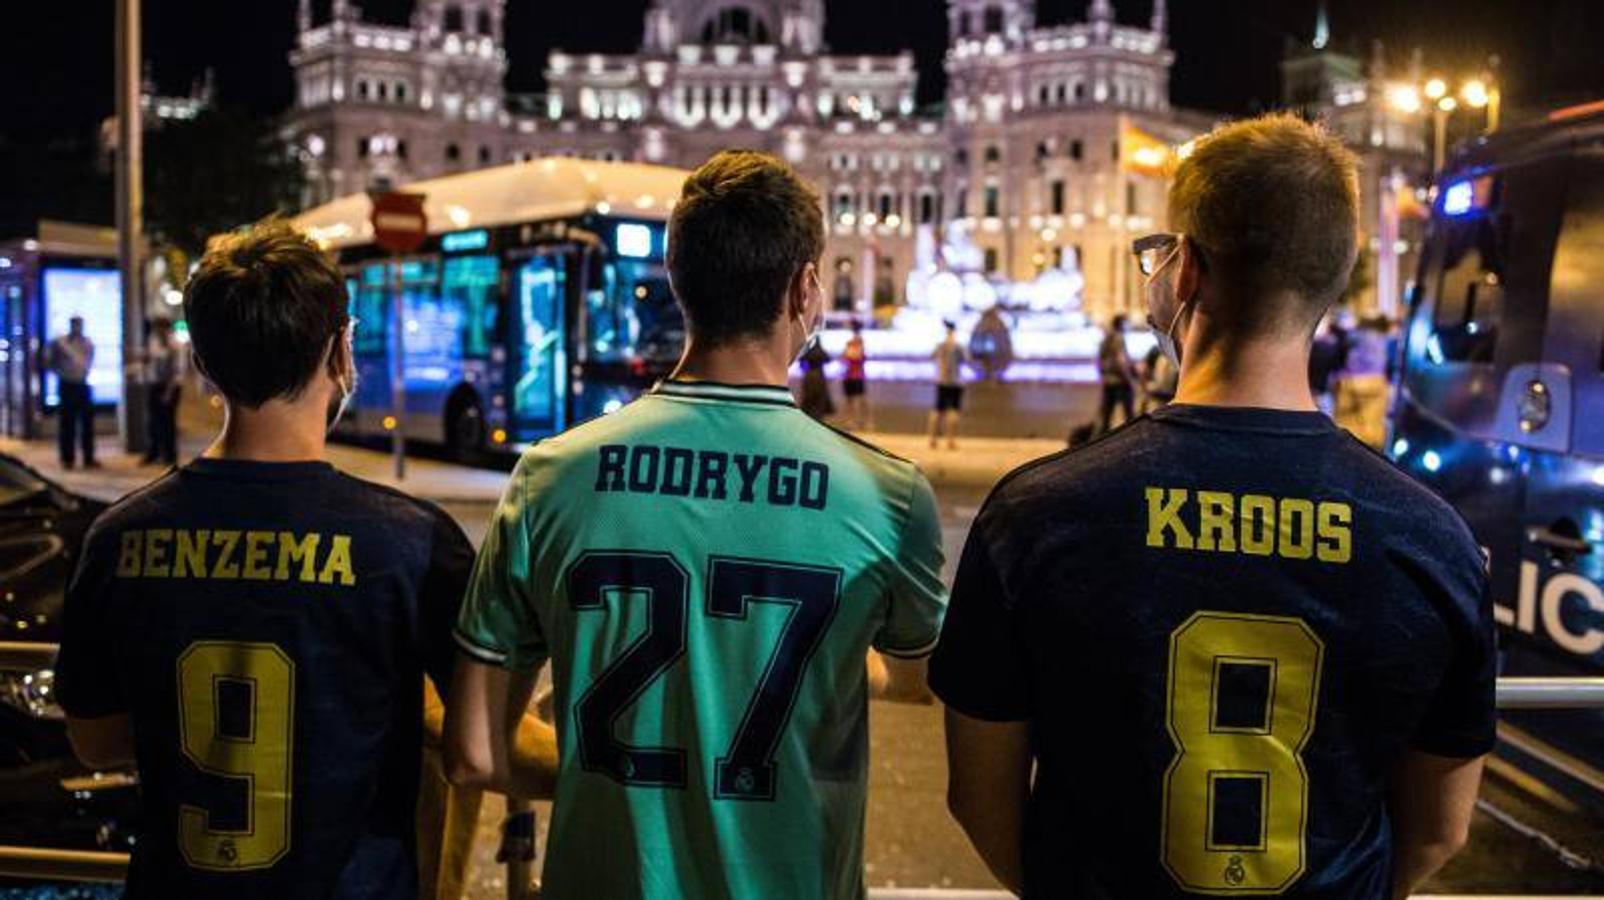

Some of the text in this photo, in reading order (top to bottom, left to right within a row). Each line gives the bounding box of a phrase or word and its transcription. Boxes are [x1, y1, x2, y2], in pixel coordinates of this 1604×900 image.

[595, 445, 829, 510] RODRYGO
[1144, 486, 1353, 564] KROOS
[119, 529, 356, 586] BENZEMA
[567, 549, 844, 801] 27
[177, 640, 296, 872] 9
[1161, 611, 1325, 895] 8
